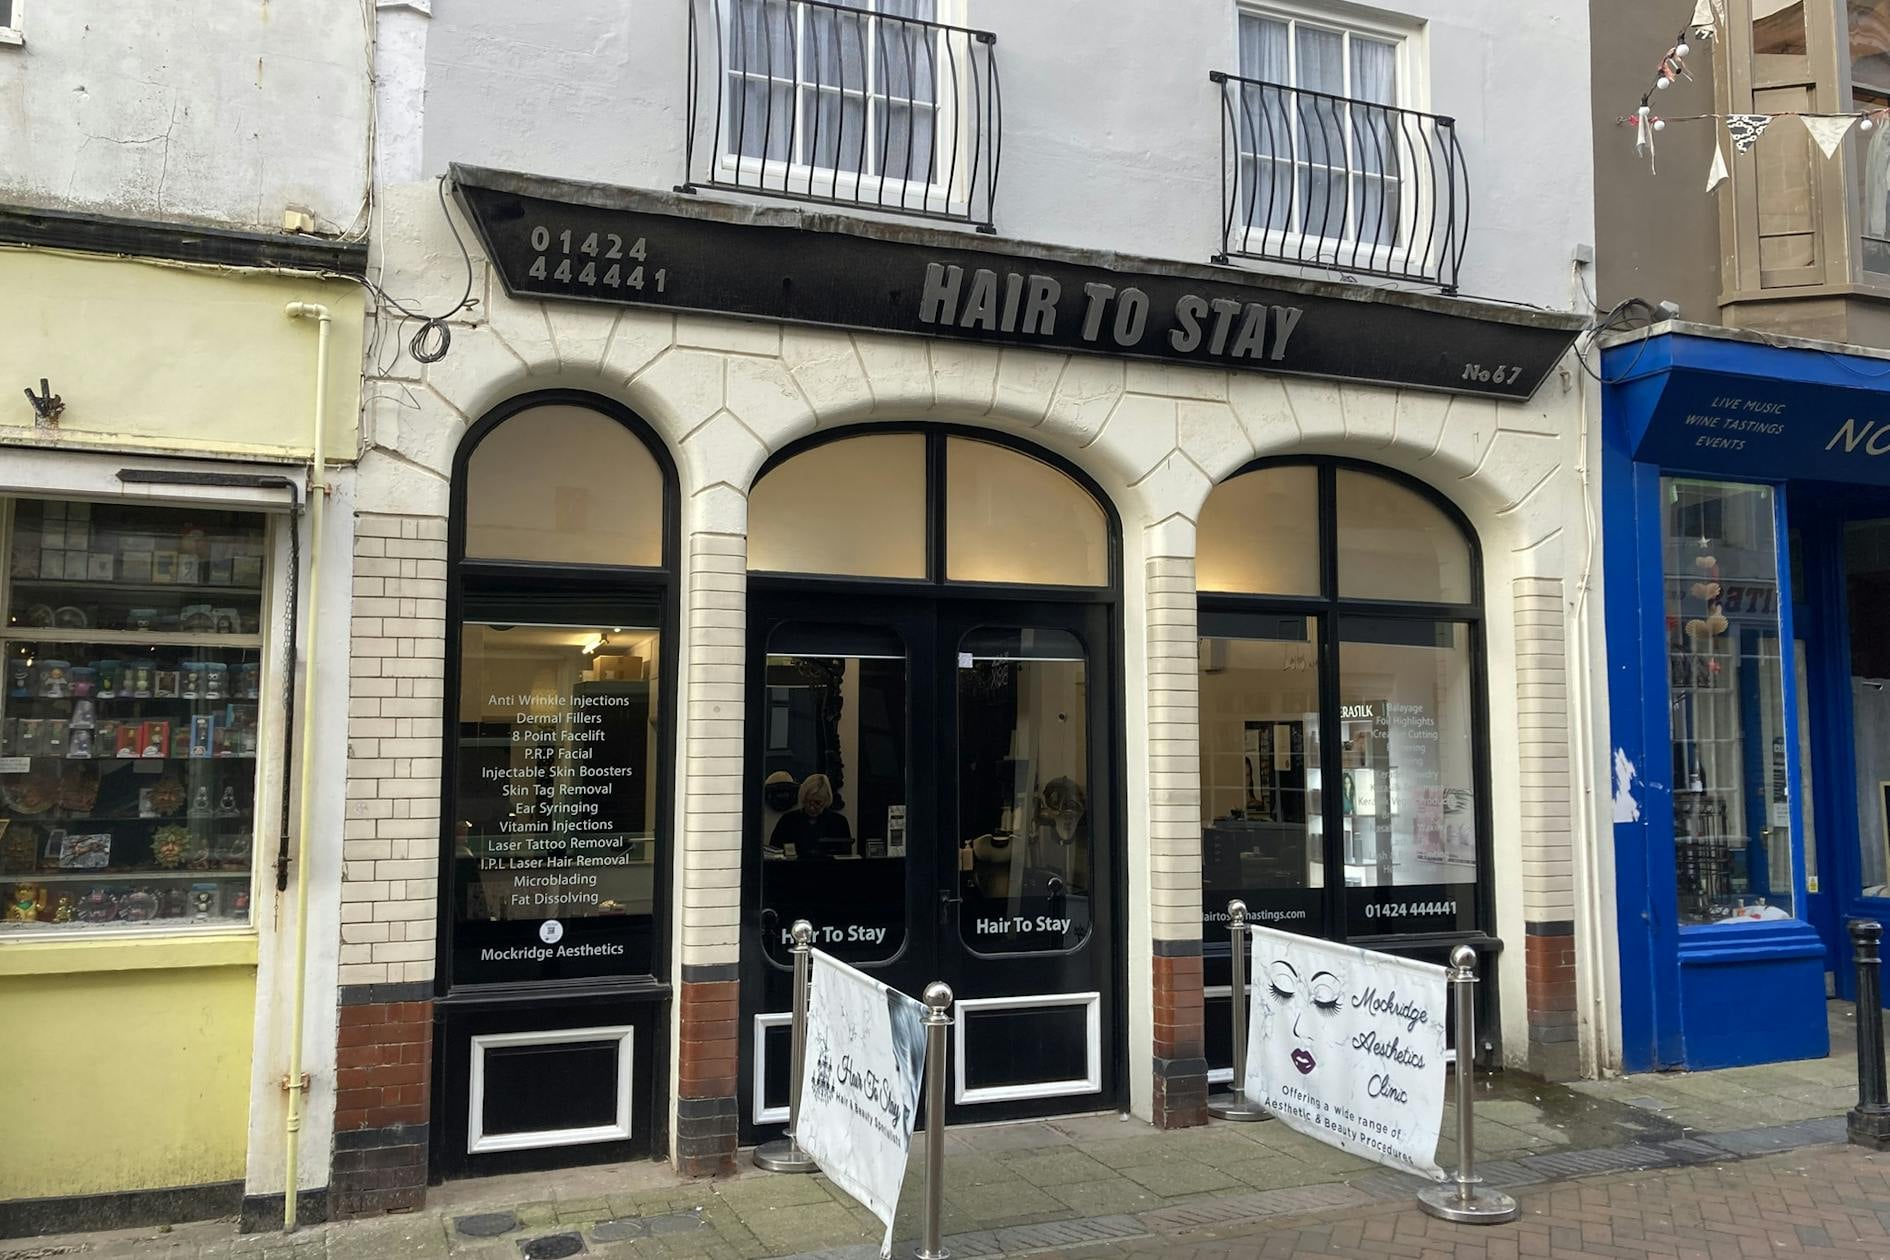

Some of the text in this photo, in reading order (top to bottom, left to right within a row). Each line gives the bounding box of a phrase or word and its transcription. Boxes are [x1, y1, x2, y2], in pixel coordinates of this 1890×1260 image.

[530, 225, 647, 262] 01424
[528, 255, 667, 293] 444441
[918, 262, 1303, 361] HAIR TO STAY
[1711, 396, 1786, 414] LIVE MUSIC
[1685, 414, 1785, 435] WINE TASTINGS
[1695, 435, 1746, 450] EVENTS
[488, 694, 630, 709] Anti Wrinkle Injections
[516, 712, 602, 724] Dermal Fillers
[512, 729, 606, 742] 8 Point Facelift
[524, 747, 593, 759] P.R.P Facial
[482, 765, 633, 780] Injectable Skin Boosters
[502, 783, 612, 798] Skin Tag Removal
[515, 802, 599, 815] Ear Syringing
[499, 819, 614, 834] Vitamin Injections
[488, 836, 623, 851] Laser Tattoo Removal
[480, 854, 630, 870] I.P.L Laser Hair Removal
[513, 873, 597, 887] Microblading
[511, 891, 599, 906] Fat Dissolving
[1365, 901, 1457, 918] 01424 444441
[976, 915, 1071, 935] Hair To Stay
[781, 924, 887, 945] Hr To Stay
[480, 943, 624, 962] Mockridge Aesthetics
[1351, 986, 1429, 1032] Mockridge
[1352, 1031, 1426, 1070] Aesthetics
[1368, 1074, 1408, 1104] Clinic
[1281, 1085, 1402, 1140] Offering a wide range of
[1264, 1097, 1414, 1165] Aesthetic & Beauty Procedures
